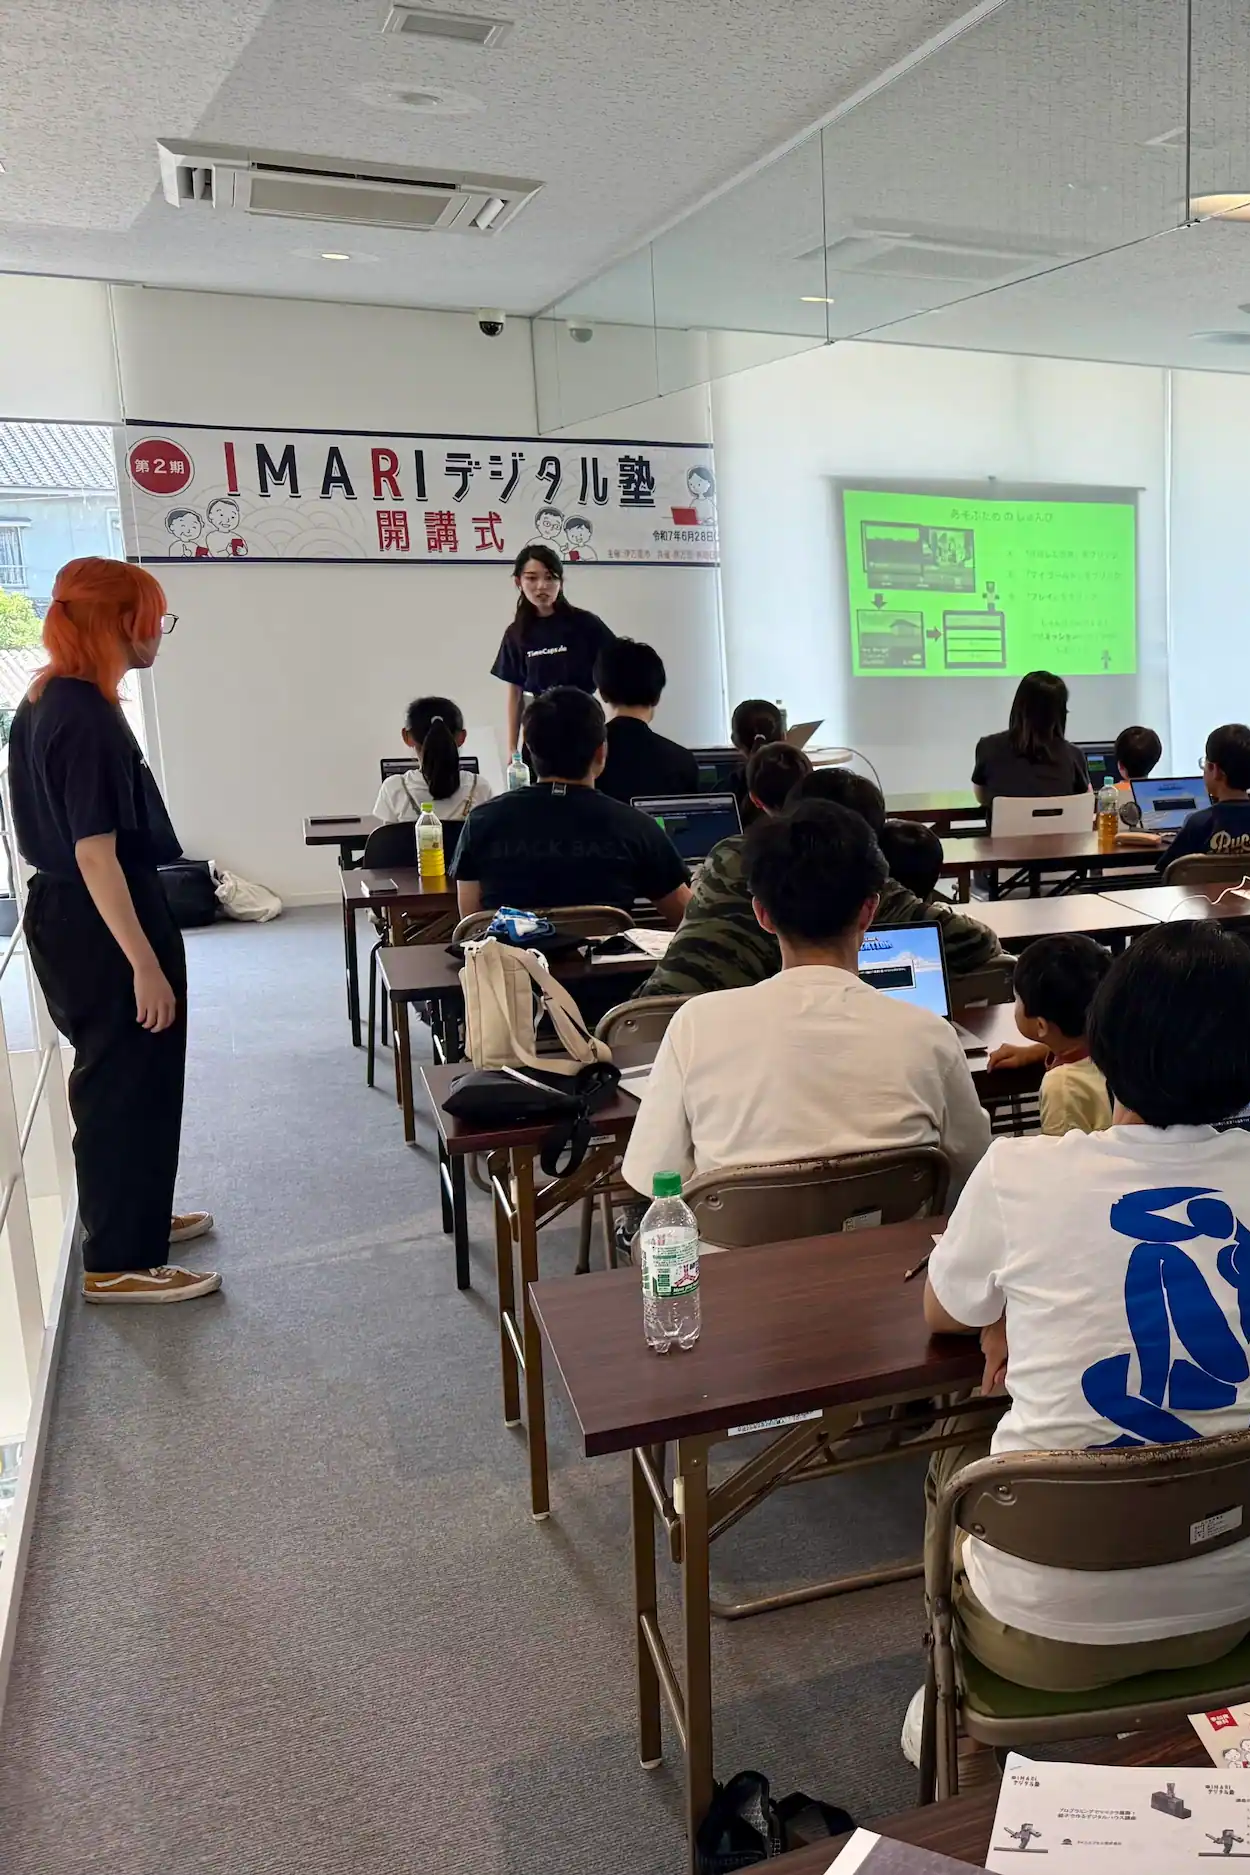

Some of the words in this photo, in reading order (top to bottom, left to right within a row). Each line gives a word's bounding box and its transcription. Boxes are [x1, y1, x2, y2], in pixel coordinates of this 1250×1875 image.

[134, 457, 185, 475] 第2期
[223, 441, 656, 508] IMARIデジタル塾
[376, 509, 505, 553] 開講式
